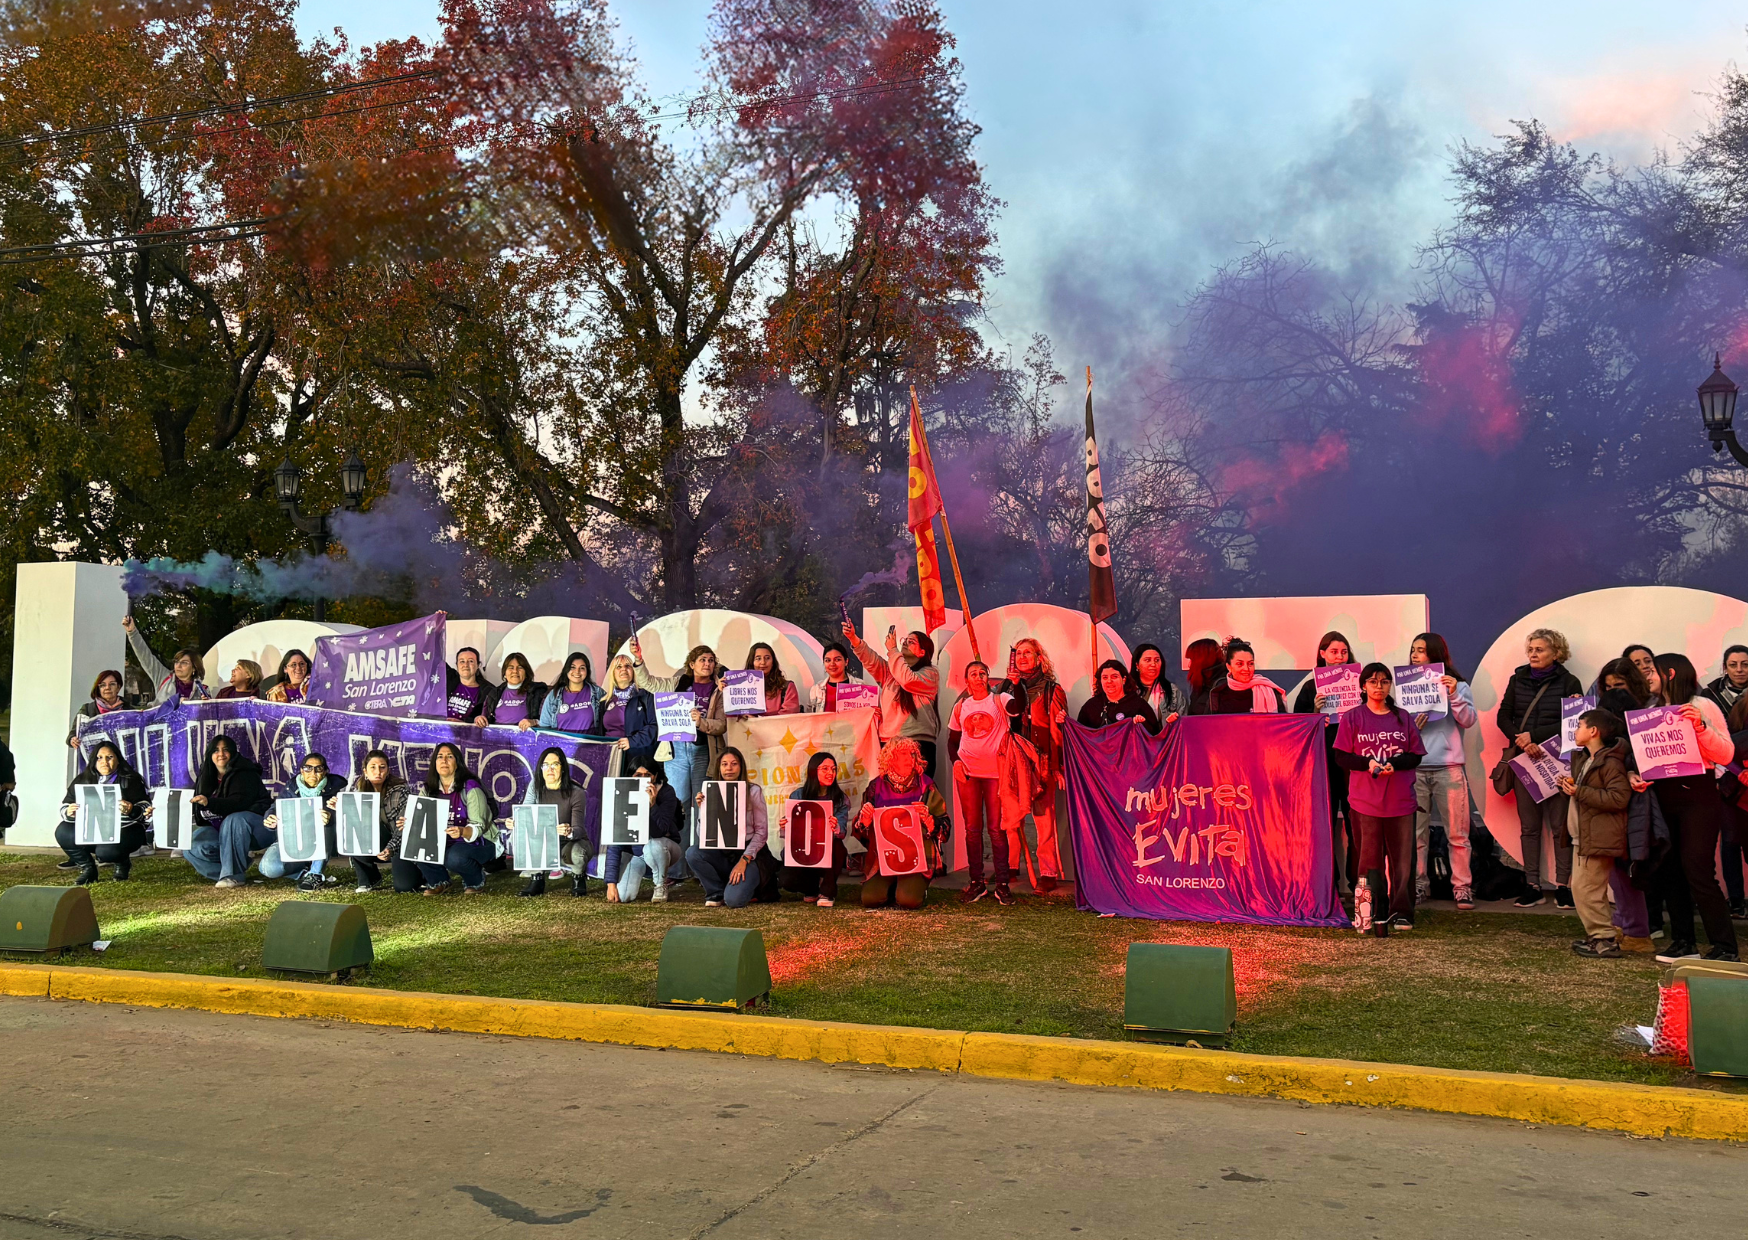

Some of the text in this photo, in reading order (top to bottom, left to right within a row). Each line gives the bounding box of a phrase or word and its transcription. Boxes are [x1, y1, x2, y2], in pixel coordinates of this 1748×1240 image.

[344, 644, 416, 682] AMSAFE
[342, 679, 416, 698] San Lorenzo
[730, 687, 757, 696] LIBRES NOS
[1402, 683, 1439, 694] NINGUNA SE
[731, 697, 757, 706] QUEREMOS
[1402, 694, 1441, 706] SALVA SOLA
[661, 709, 683, 717] NINGUNA
[662, 719, 691, 727] SALVA SOLA
[1357, 731, 1406, 745] mujeres
[1641, 729, 1683, 744] VIVAS NOS
[1645, 743, 1686, 759] QUEREMOS
[1125, 784, 1252, 819] mujeres
[1136, 874, 1226, 889] SAN LORENZO
